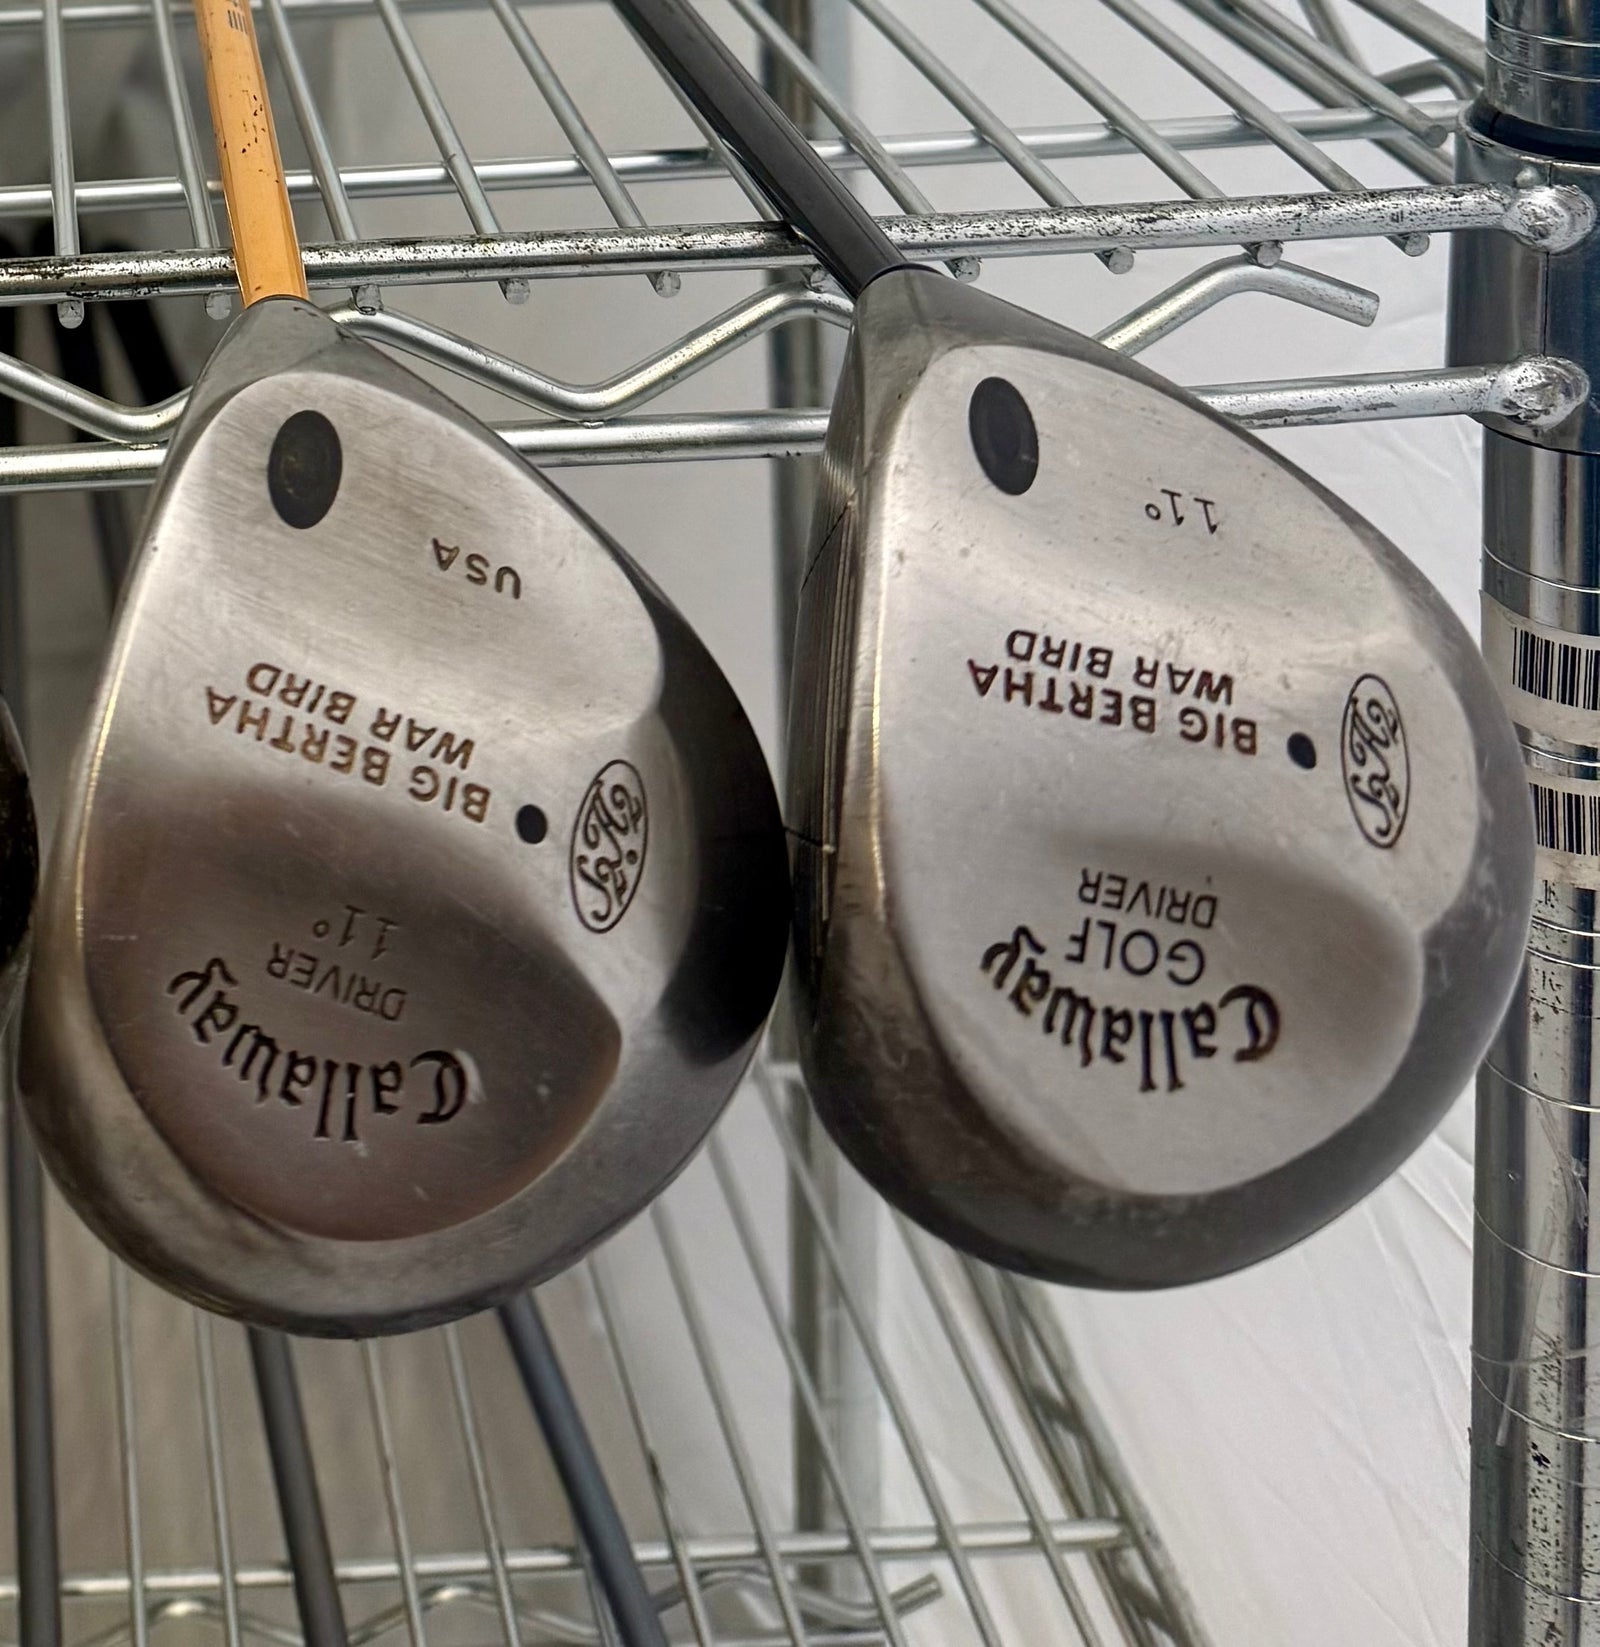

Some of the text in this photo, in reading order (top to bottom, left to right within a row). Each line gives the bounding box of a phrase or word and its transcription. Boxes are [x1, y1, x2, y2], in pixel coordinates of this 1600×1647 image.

[431, 537, 523, 600] USA
[967, 658, 1257, 756] BIG BERTHA
[1007, 628, 1235, 705] WAR BIRD
[206, 684, 493, 824] BIG BERTHA
[246, 662, 476, 771] WAR BIRD
[1078, 868, 1218, 930] DRIVER
[266, 940, 409, 1023] DRIVER
[1065, 918, 1207, 987] GOLF
[166, 958, 468, 1143] Callaway
[980, 925, 1281, 1094] Callaway
